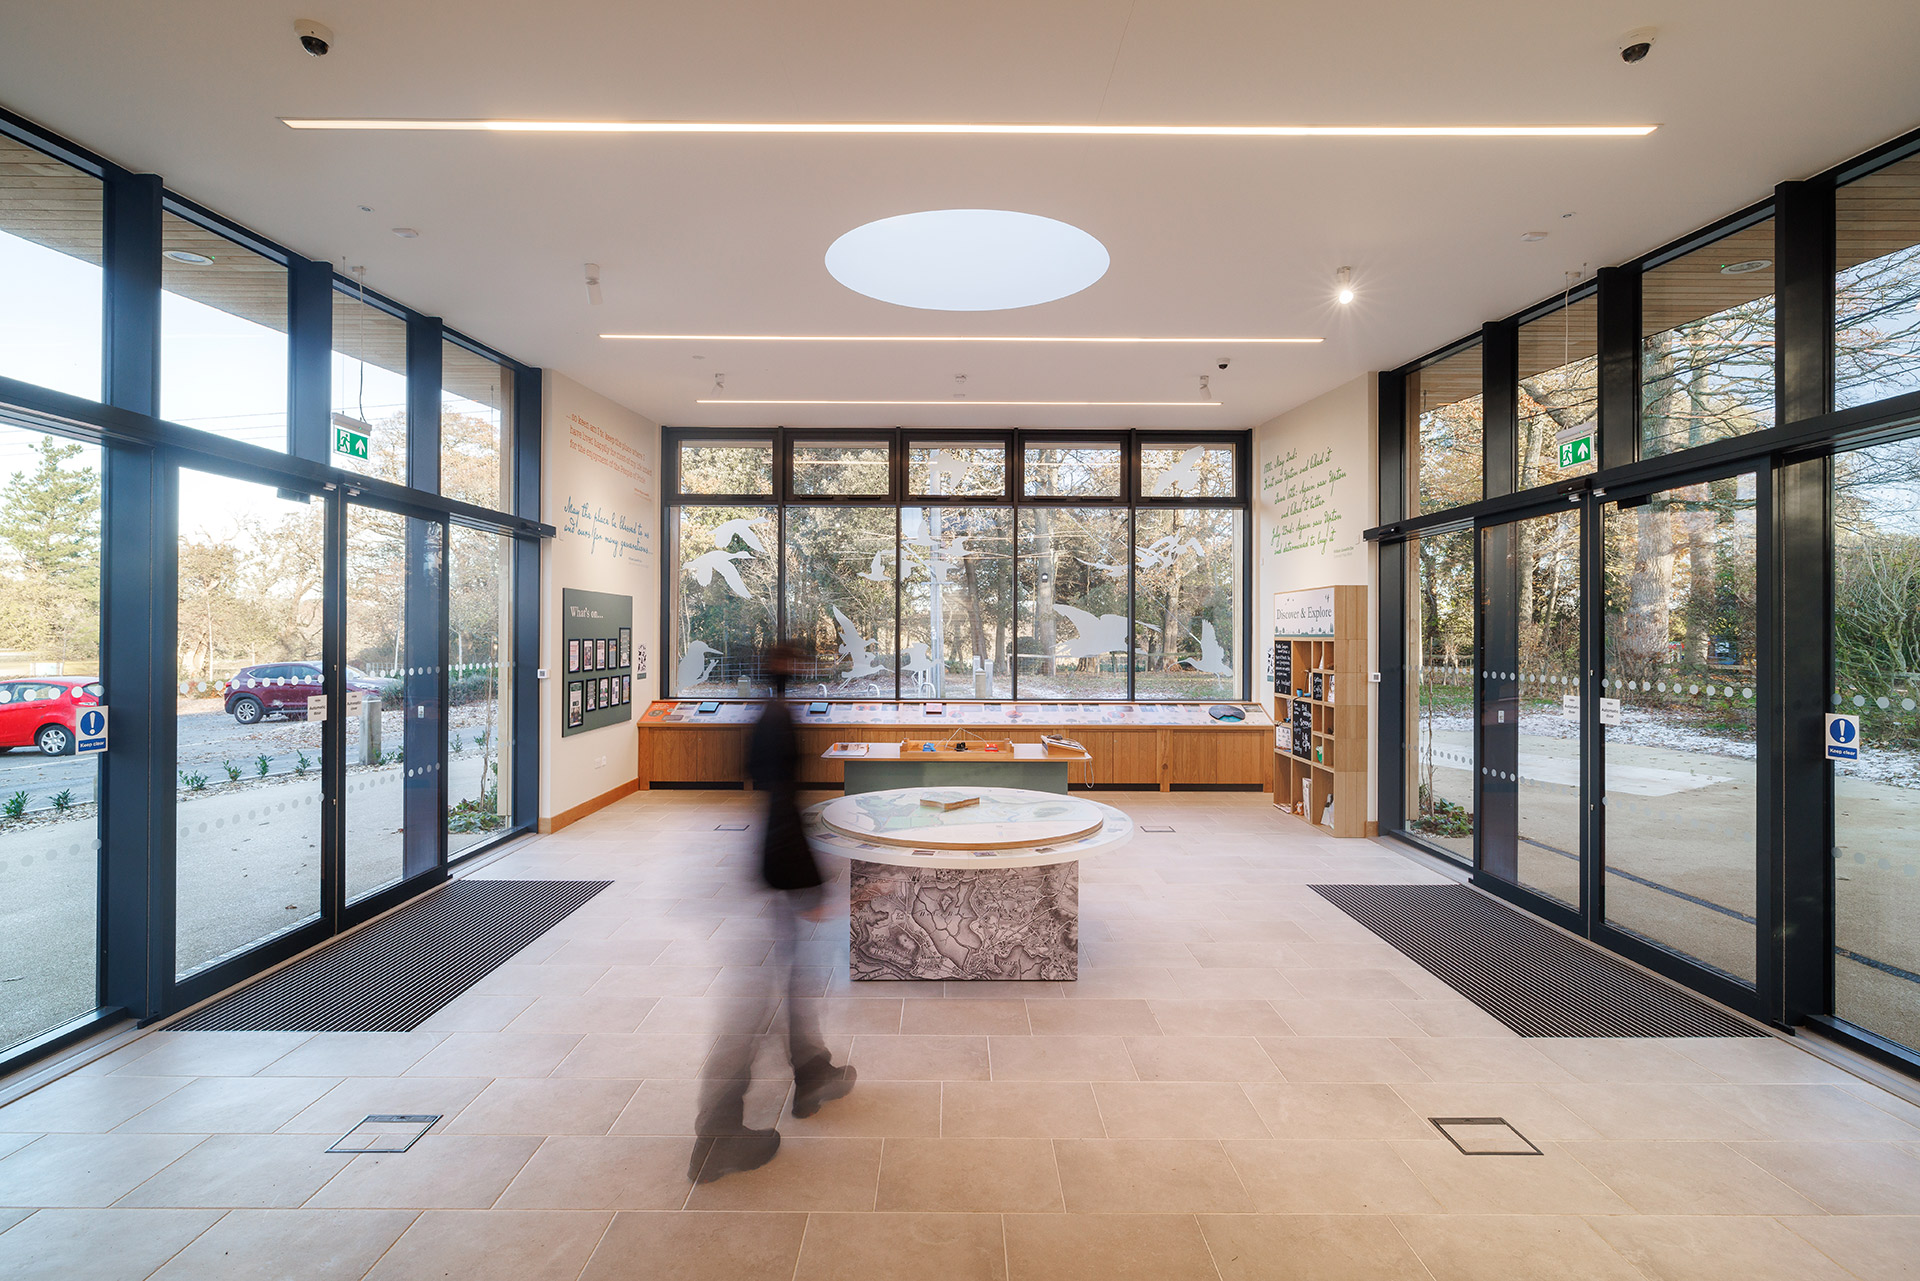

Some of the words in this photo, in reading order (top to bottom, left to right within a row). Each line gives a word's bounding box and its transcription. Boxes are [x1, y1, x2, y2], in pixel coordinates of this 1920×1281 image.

[578, 415, 589, 429] keen
[570, 424, 582, 439] have
[594, 438, 609, 455] happily
[569, 439, 577, 450] for
[577, 443, 586, 455] the
[586, 448, 608, 467] enjoyment
[1325, 446, 1333, 462] it
[564, 496, 579, 527] May
[581, 502, 591, 520] the
[592, 507, 609, 536] place
[619, 514, 637, 534] blessed
[637, 522, 643, 537] to
[570, 605, 590, 618] What's
[1276, 608, 1300, 620] Discover
[1300, 607, 1306, 619] &
[1307, 605, 1332, 622] Explore
